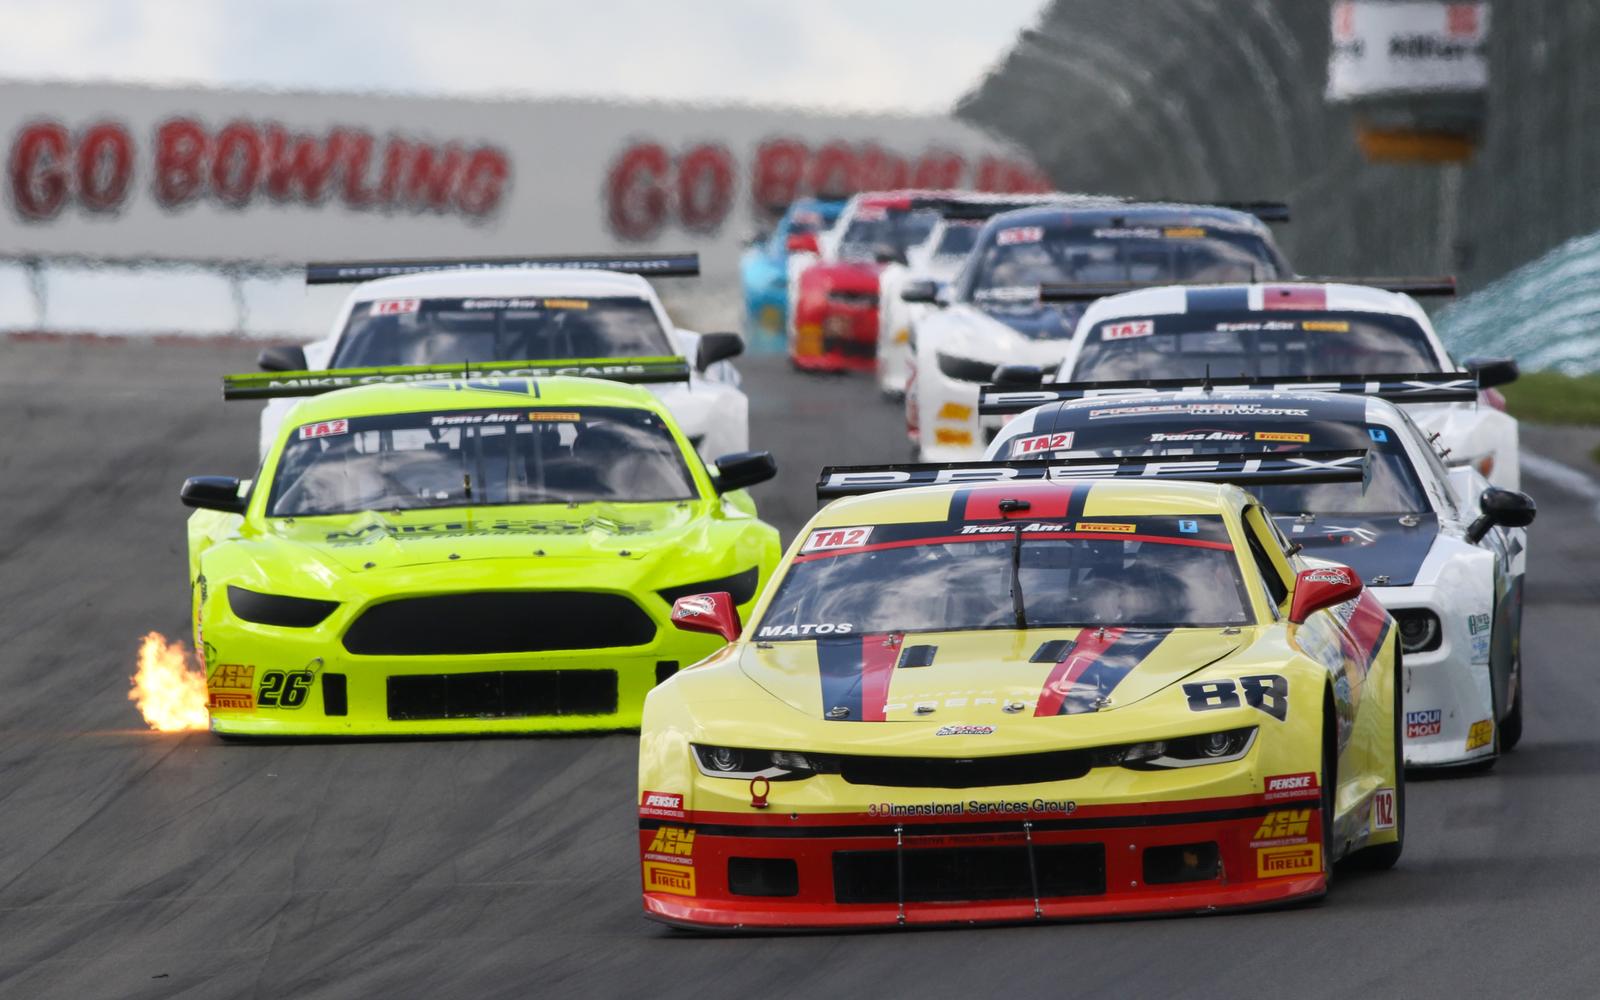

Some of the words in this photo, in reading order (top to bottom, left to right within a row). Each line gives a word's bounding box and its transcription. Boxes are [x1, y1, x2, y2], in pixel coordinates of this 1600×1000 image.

[10, 119, 135, 220] GO
[153, 115, 511, 224] BOWLING
[606, 140, 734, 240] GO
[1110, 323, 1148, 337] TA2
[269, 378, 351, 388] MIKE
[556, 365, 645, 376] CARS
[304, 420, 346, 438] TA2
[1150, 433, 1204, 442] Trans
[1205, 431, 1243, 441] Am
[1021, 435, 1068, 453] TA2
[828, 457, 1363, 488] PREFIX
[960, 524, 1018, 534] Trans
[1022, 522, 1065, 533] Am
[813, 529, 865, 547] TA2
[758, 623, 853, 637] MATOS
[207, 664, 255, 688] AEM
[257, 669, 314, 710] 26
[1182, 674, 1288, 722] 88
[209, 693, 253, 709] PIRELLI
[1407, 711, 1441, 724] LIQUI
[1408, 724, 1441, 736] MOLY
[1268, 776, 1311, 790] PENSKE
[646, 795, 681, 808] PENSKE
[868, 801, 964, 816] 3-Dimensional
[968, 799, 1029, 814] Services
[1032, 798, 1077, 815] Group
[1375, 793, 1393, 825] TA2
[1254, 809, 1311, 839] AEM
[647, 827, 697, 856] AEM
[1263, 850, 1313, 872] PIRELLI
[650, 867, 691, 889] PIRELLI
